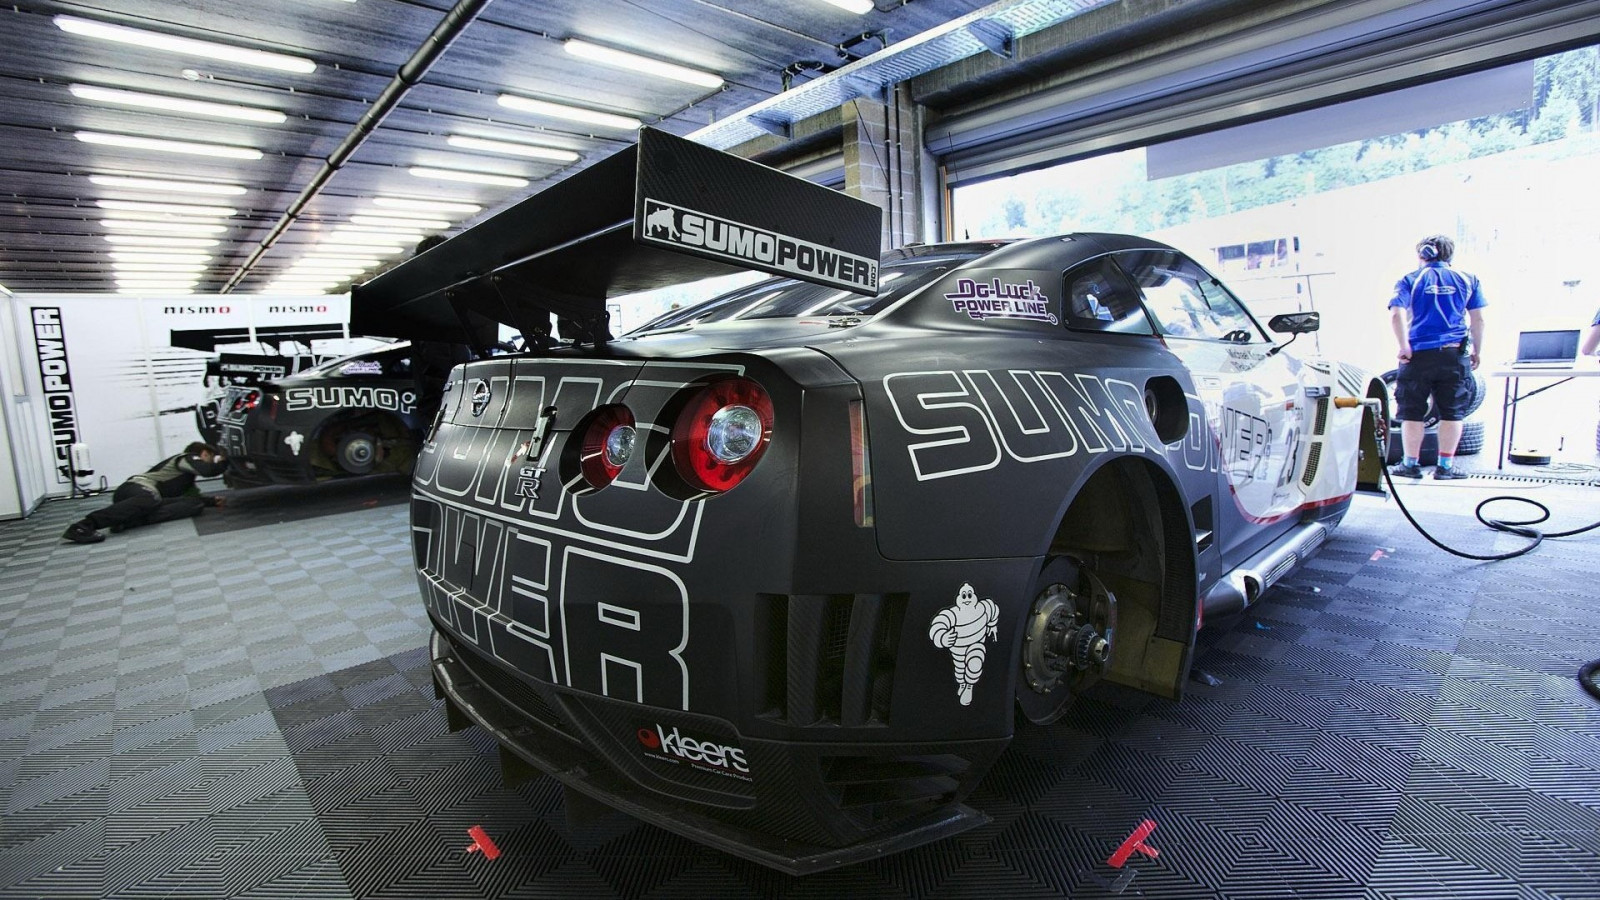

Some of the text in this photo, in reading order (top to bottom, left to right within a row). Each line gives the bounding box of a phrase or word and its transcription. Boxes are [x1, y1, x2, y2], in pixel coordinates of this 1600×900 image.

[164, 305, 231, 315] nismo
[269, 305, 327, 313] nismo
[954, 299, 1046, 315] POWER LINE
[287, 386, 399, 412] SUMO
[656, 723, 750, 773] kleers
